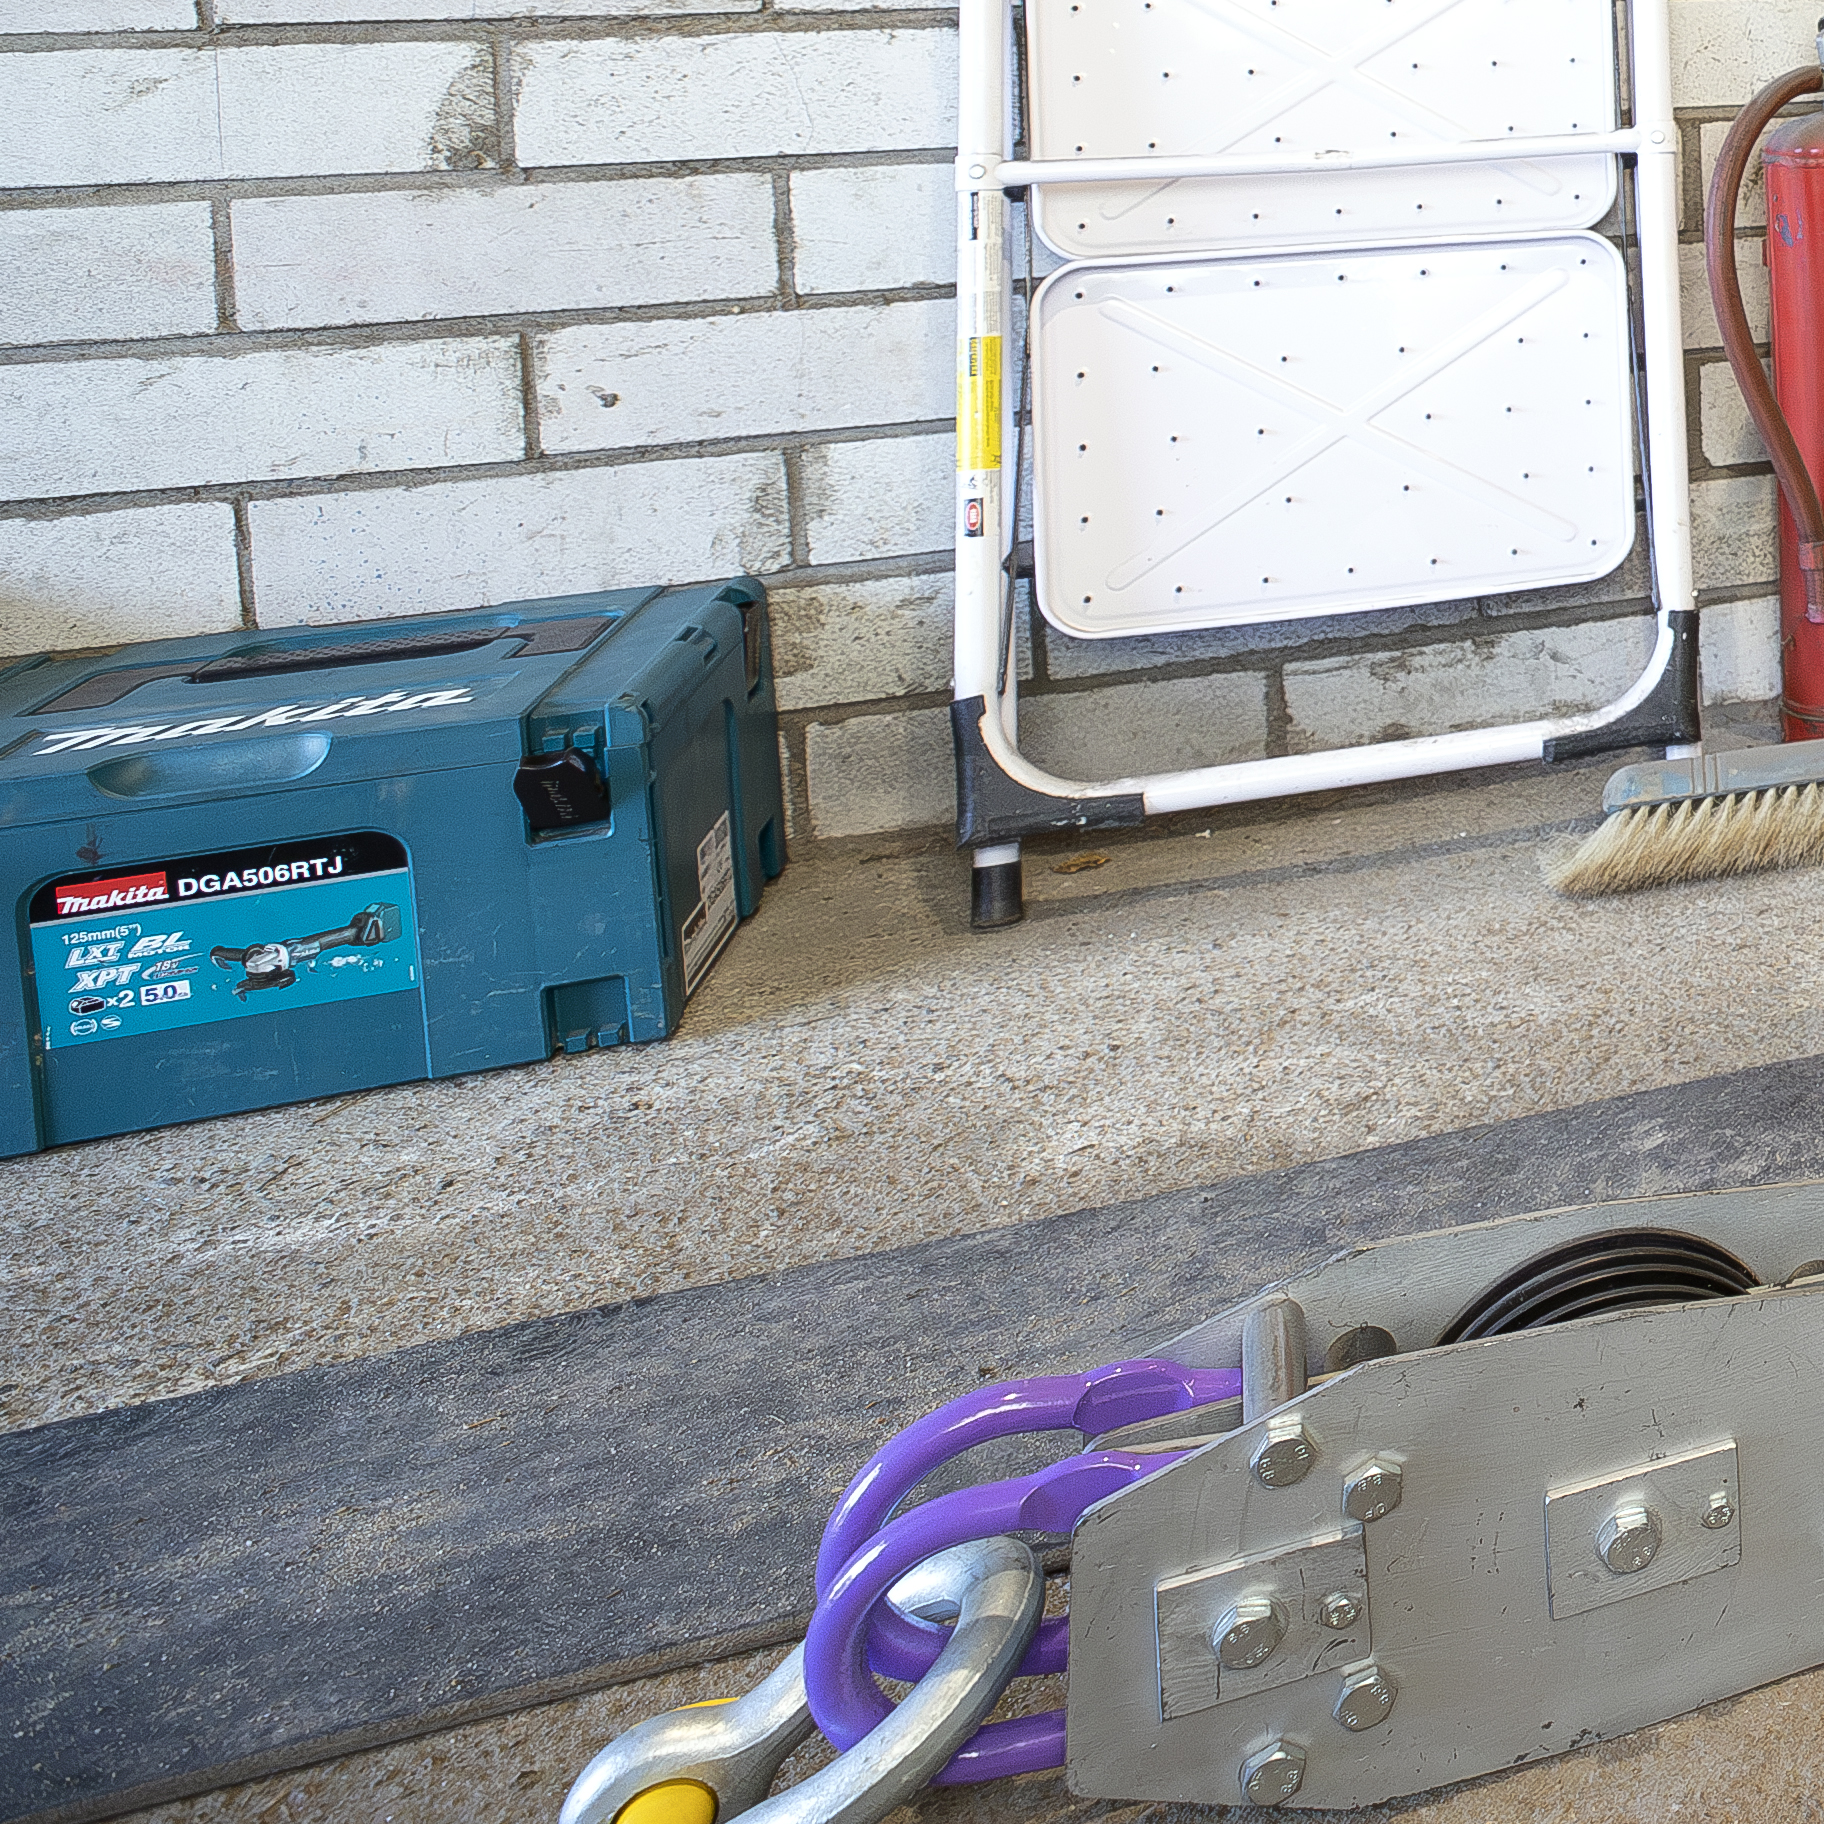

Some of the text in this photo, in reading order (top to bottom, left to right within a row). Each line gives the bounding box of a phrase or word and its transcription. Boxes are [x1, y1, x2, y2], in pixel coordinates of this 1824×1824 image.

[57, 856, 343, 914] Makita DGA506RTJ
[68, 962, 142, 994] XPT
